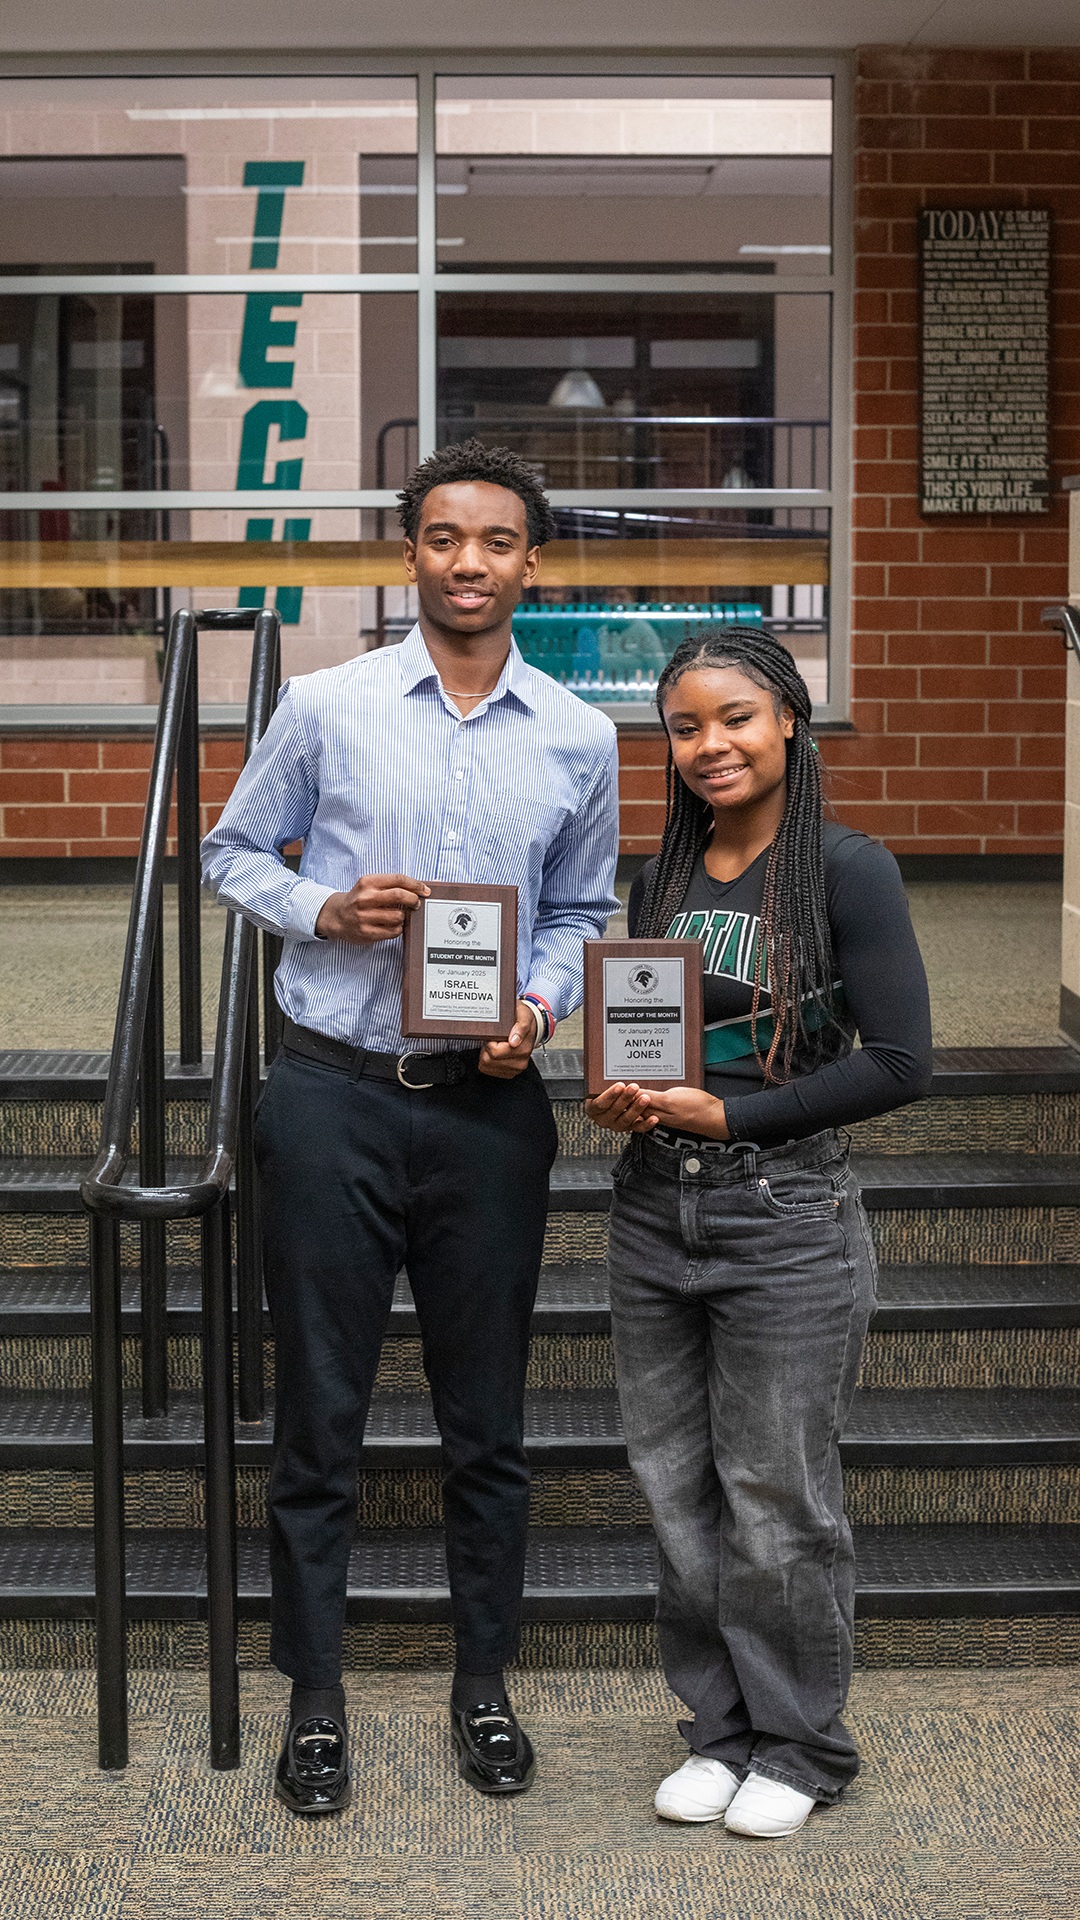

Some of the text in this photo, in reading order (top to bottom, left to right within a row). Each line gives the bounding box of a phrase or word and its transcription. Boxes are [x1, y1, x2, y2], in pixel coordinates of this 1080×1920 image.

[923, 210, 1004, 239] TODAY
[1005, 210, 1014, 222] IS
[1016, 210, 1029, 222] THE
[924, 290, 935, 303] BE
[937, 290, 981, 303] GENEROUS
[984, 290, 1002, 303] AND
[923, 325, 964, 338] EMBRACE
[966, 325, 986, 338] NEW
[1004, 351, 1015, 363] BE
[923, 412, 951, 423] SEEK
[953, 412, 987, 423] PEACE
[990, 412, 1013, 423] AND
[923, 455, 1049, 469] SMILE AT STRANGERS.
[923, 482, 952, 496] THIS
[955, 482, 967, 496] IS
[970, 482, 1004, 496] YOUR
[923, 498, 1049, 512] MAKE IT BEAUTIFUL.
[444, 939, 471, 947] Honoring
[447, 969, 470, 977] January
[444, 980, 479, 989] ISRAEL
[429, 991, 493, 1001] MUSHENDWA
[625, 1039, 664, 1047] ANIYAH
[627, 1050, 661, 1058] JONES
